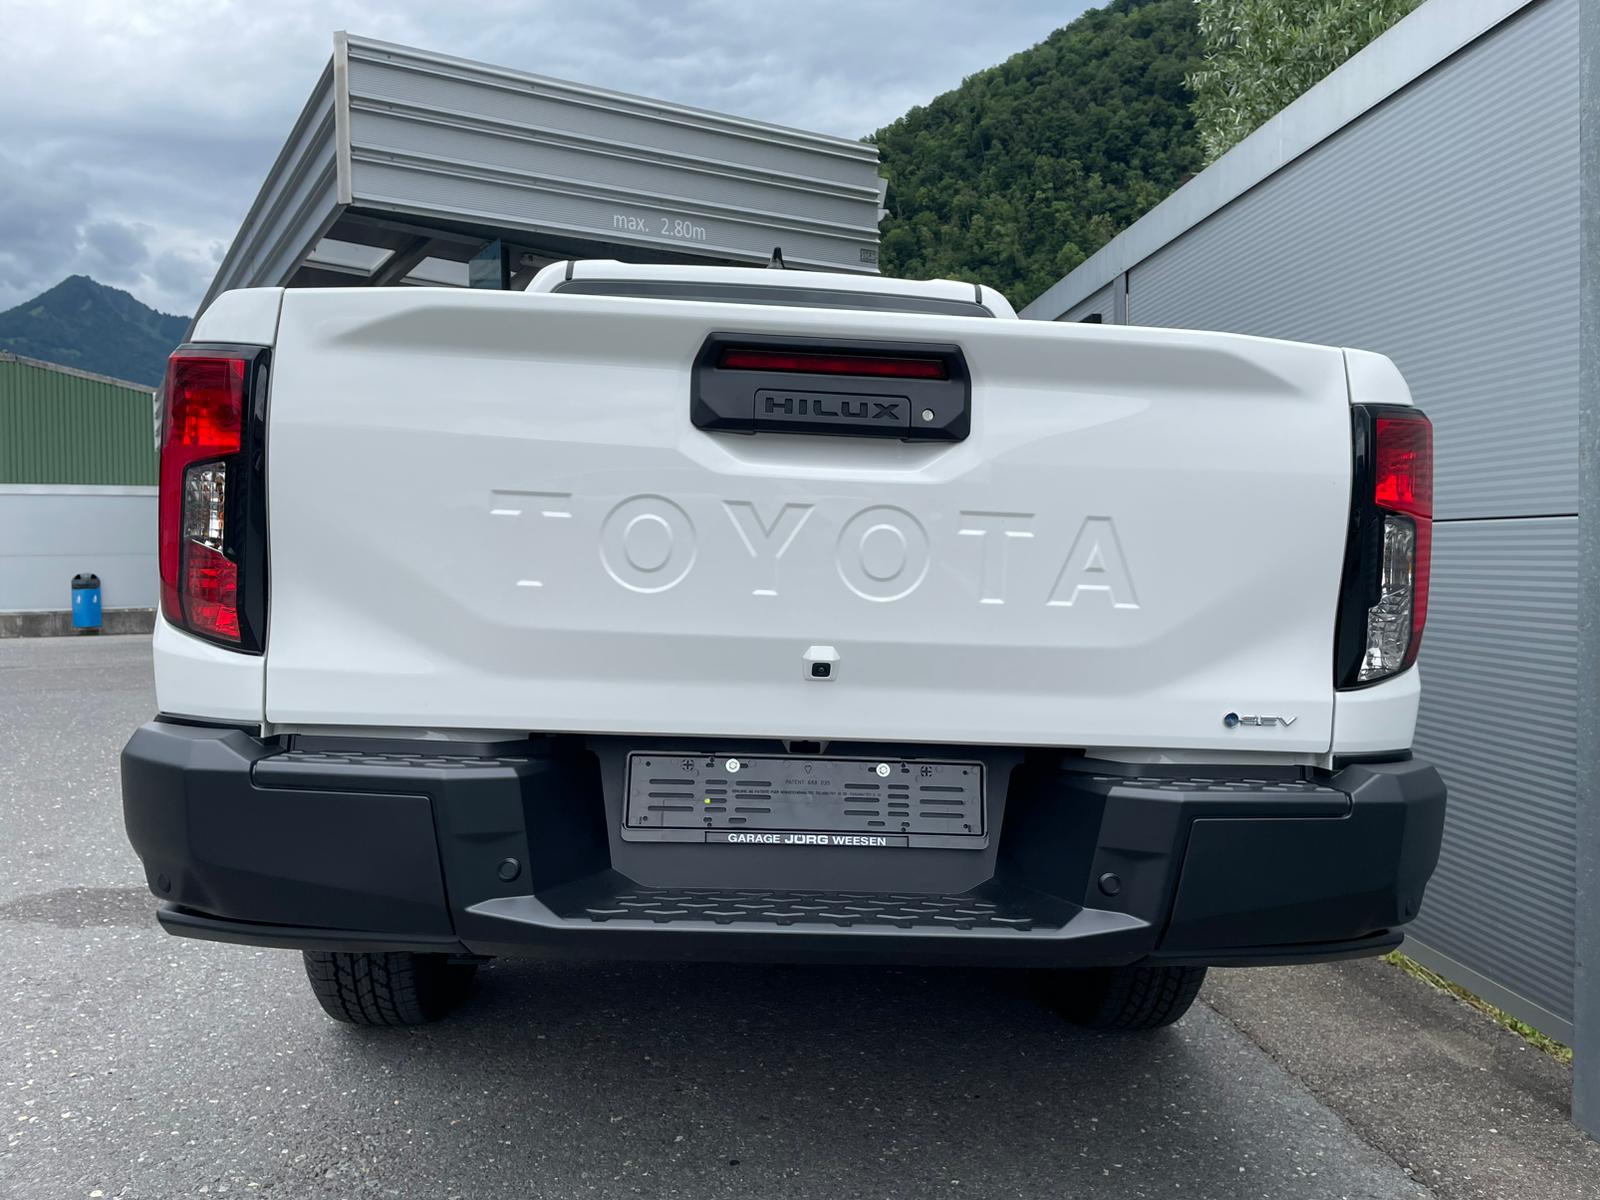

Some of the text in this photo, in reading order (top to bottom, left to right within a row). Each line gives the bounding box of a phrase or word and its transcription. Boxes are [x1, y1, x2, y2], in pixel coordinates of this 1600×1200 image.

[613, 213, 706, 241] max. 2.80m
[764, 397, 900, 421] HILUX
[490, 489, 1140, 610] TOYOTA
[728, 833, 886, 846] GARAGE JÜRG WEESEN
